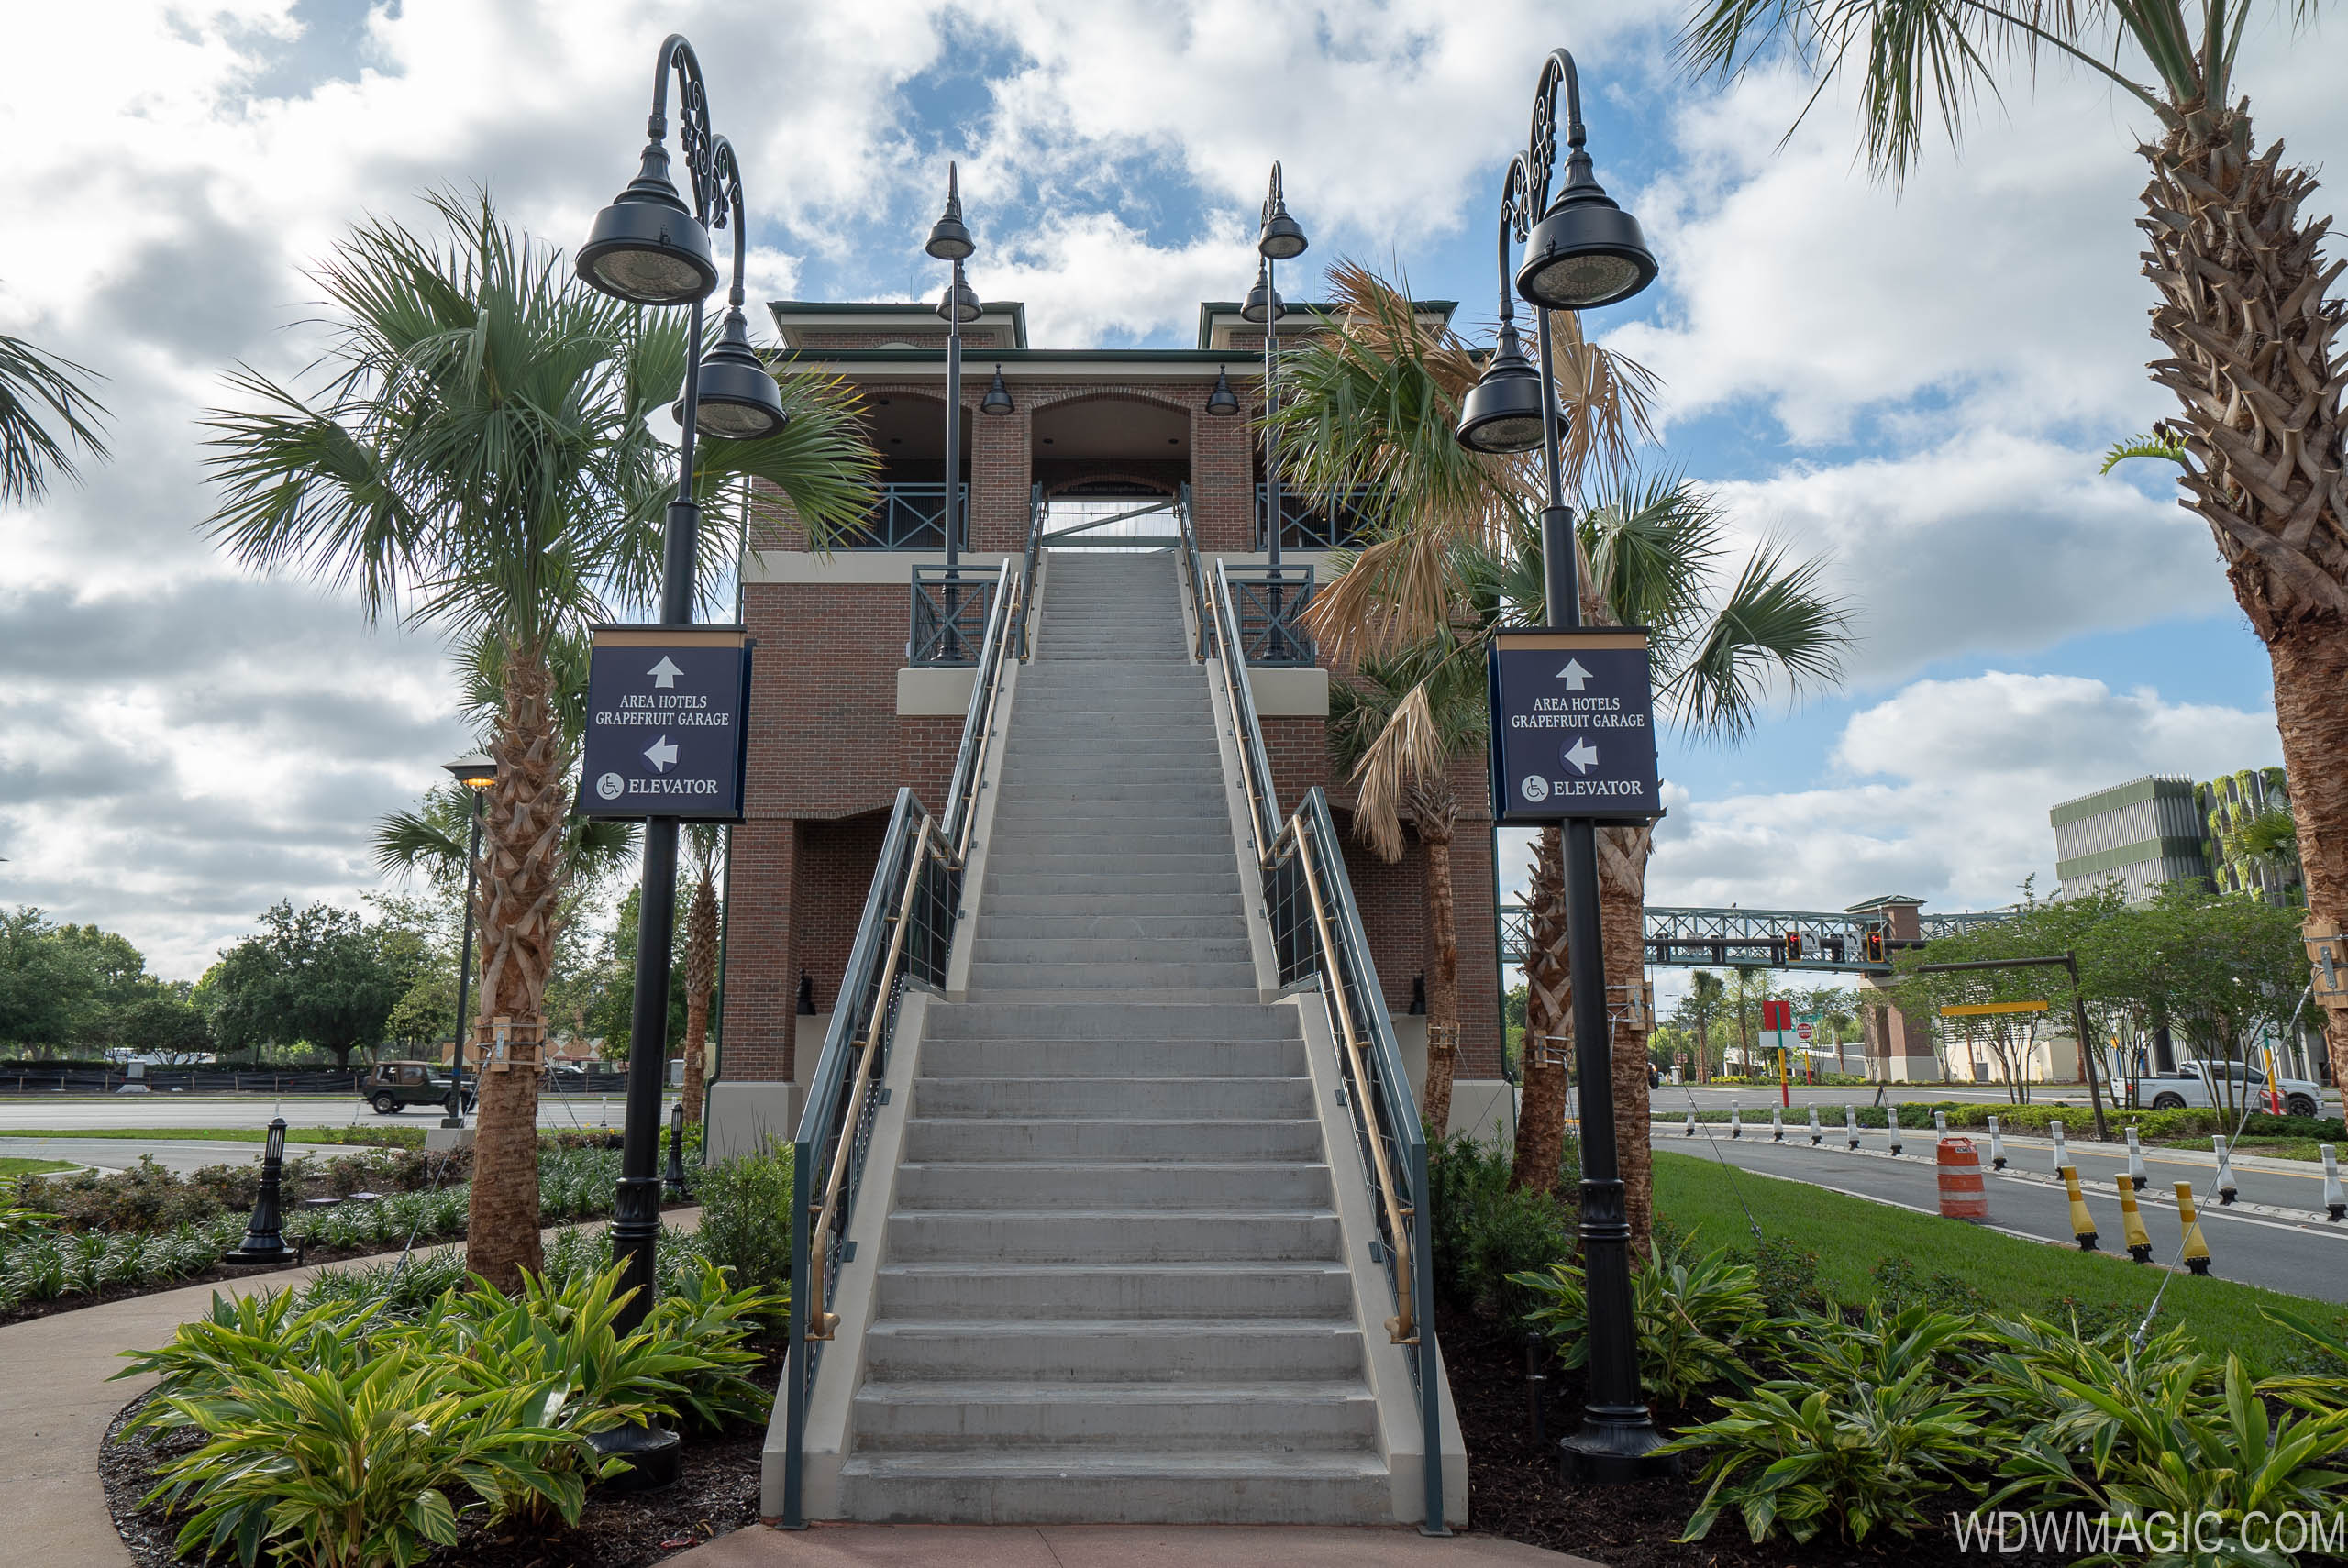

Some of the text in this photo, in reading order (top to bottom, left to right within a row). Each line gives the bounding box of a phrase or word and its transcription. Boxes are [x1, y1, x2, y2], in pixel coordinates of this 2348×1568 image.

[619, 694, 707, 709] AREA HOTELS
[1533, 697, 1621, 712] AREA HOTELS
[595, 712, 729, 726] GRAPEFRUIT GARAGE
[1511, 713, 1645, 728] GRAPEFRUIT GARAGE
[628, 778, 719, 794] ELEVATOR
[1553, 780, 1644, 796] ELEVATOR
